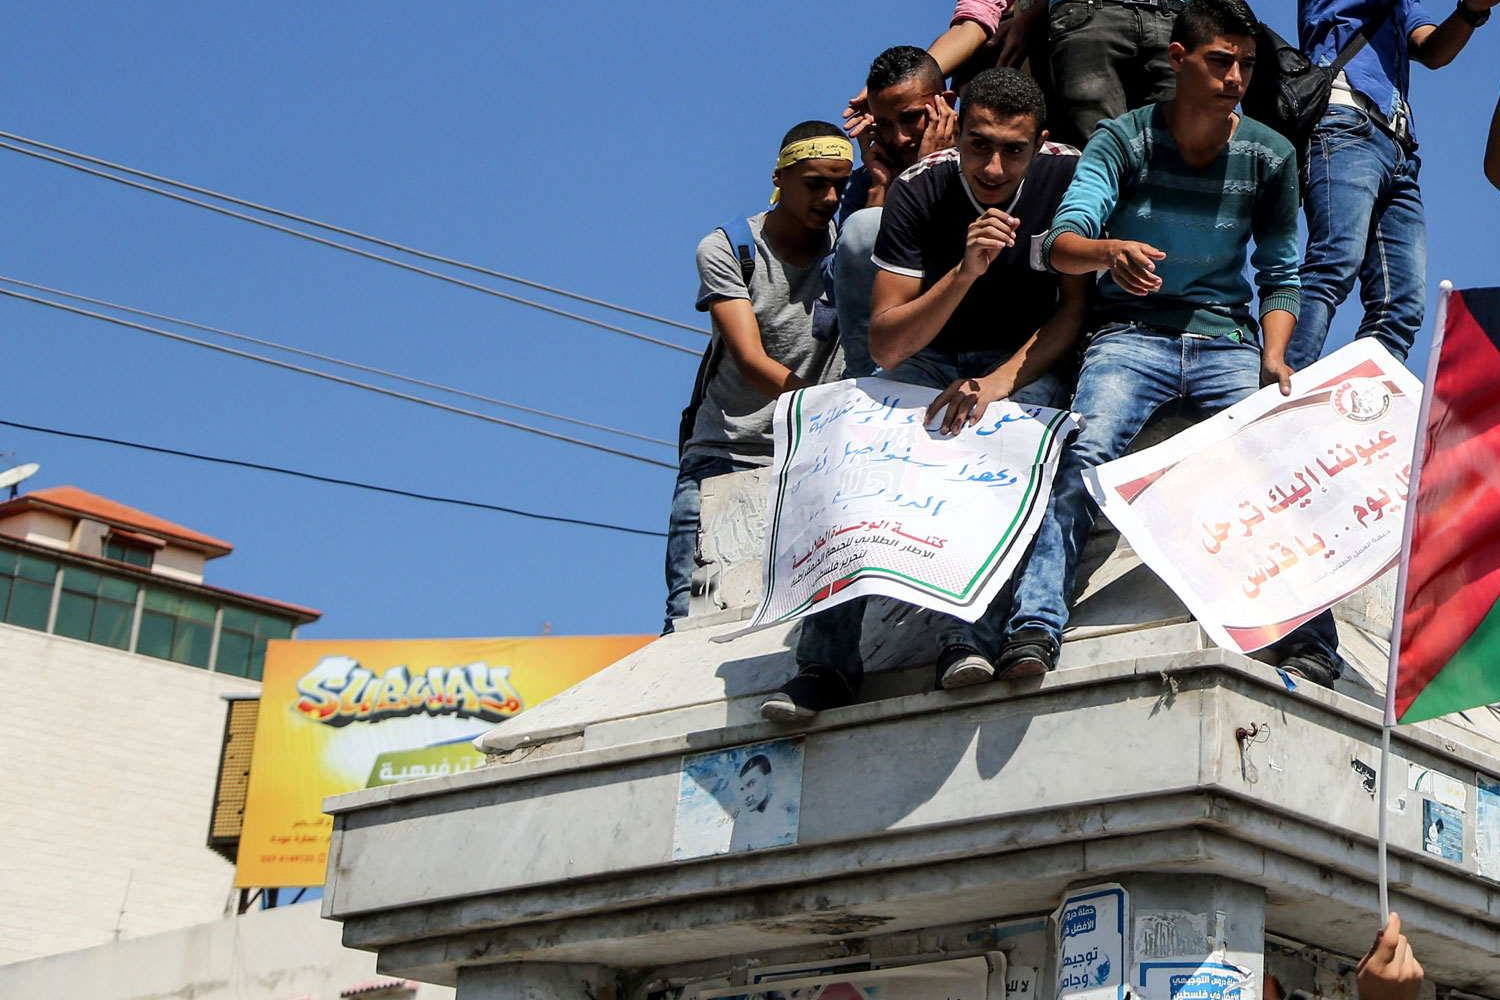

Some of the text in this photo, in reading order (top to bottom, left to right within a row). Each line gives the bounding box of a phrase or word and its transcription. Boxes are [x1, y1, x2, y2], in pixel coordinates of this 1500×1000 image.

[1202, 430, 1397, 555] عيوننا إليك ترحل
[1353, 488, 1401, 529] يوم
[830, 519, 890, 540] الوحدة
[1294, 532, 1335, 559] يا
[1242, 542, 1299, 599] قدس
[291, 655, 524, 727] SUBWAY
[1065, 907, 1094, 921] حملة درو
[1071, 919, 1095, 935] الأفضل
[1063, 947, 1098, 968] توجيه
[1061, 972, 1089, 989] وجام
[1172, 975, 1210, 986] التوجيهي
